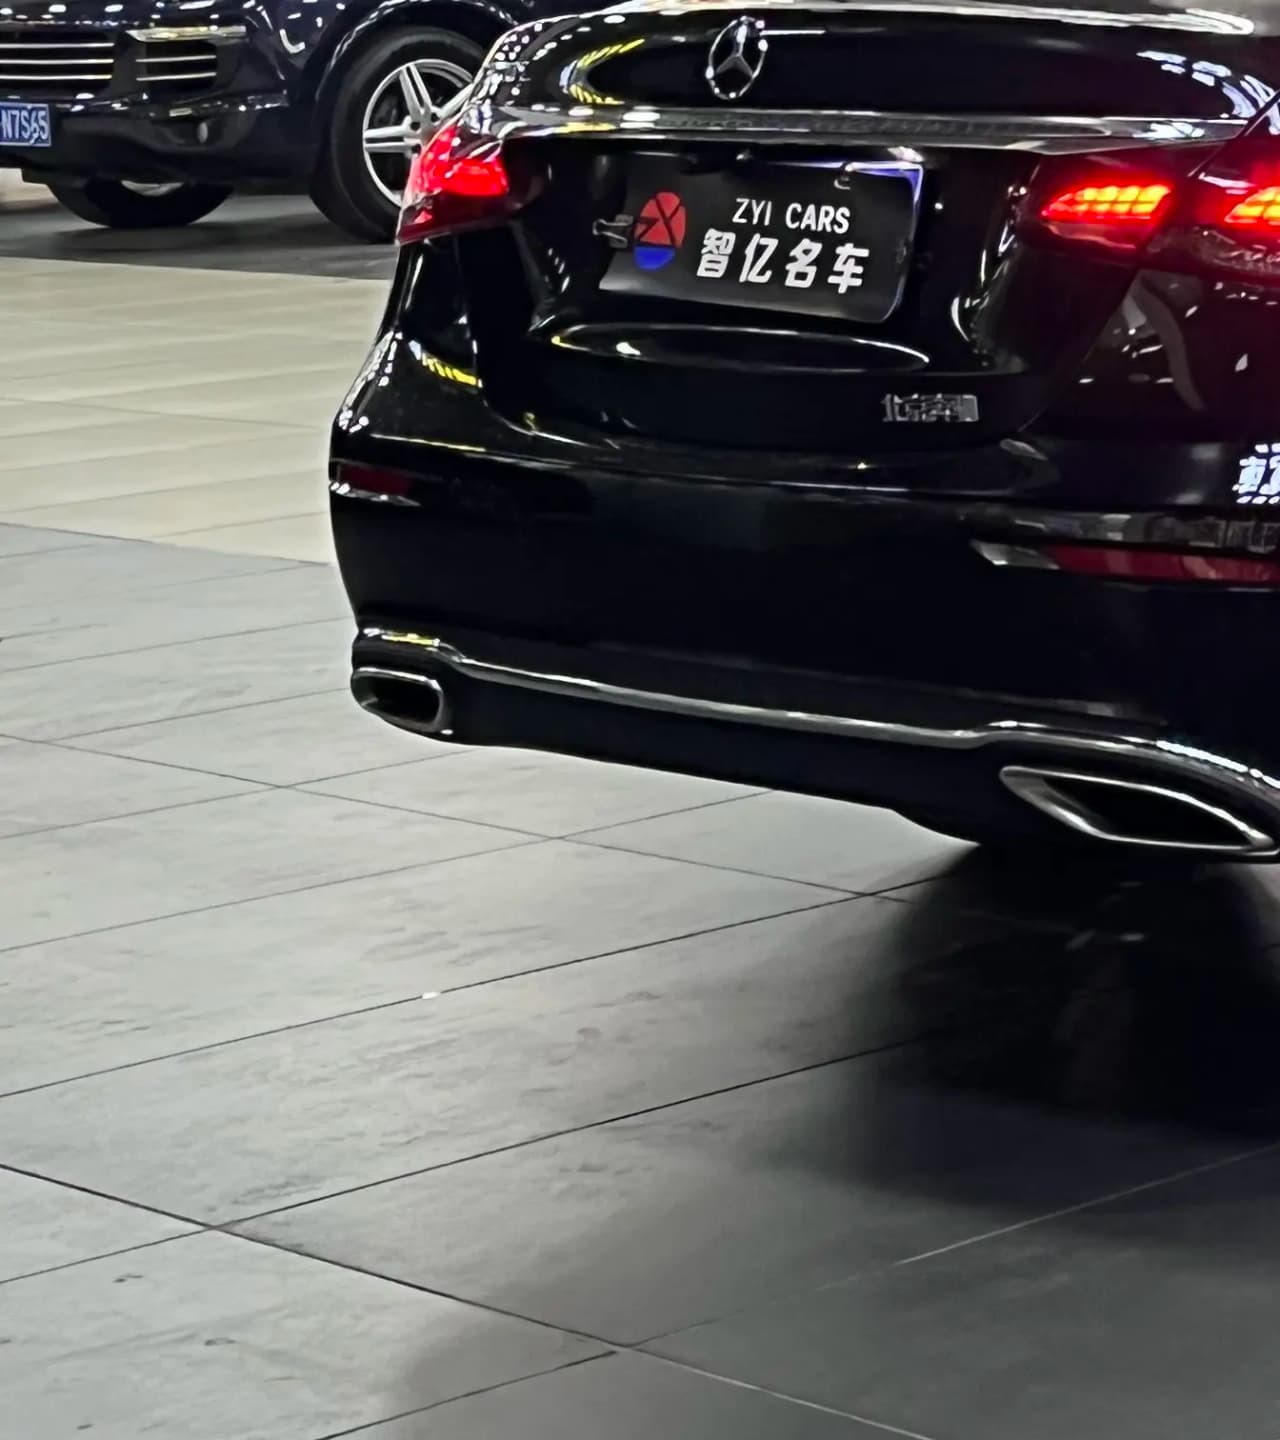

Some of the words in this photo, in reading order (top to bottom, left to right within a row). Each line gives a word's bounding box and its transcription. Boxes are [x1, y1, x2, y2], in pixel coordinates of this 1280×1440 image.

[732, 197, 772, 226] ZYI
[785, 202, 851, 235] CARS
[696, 227, 870, 294] 智亿名车
